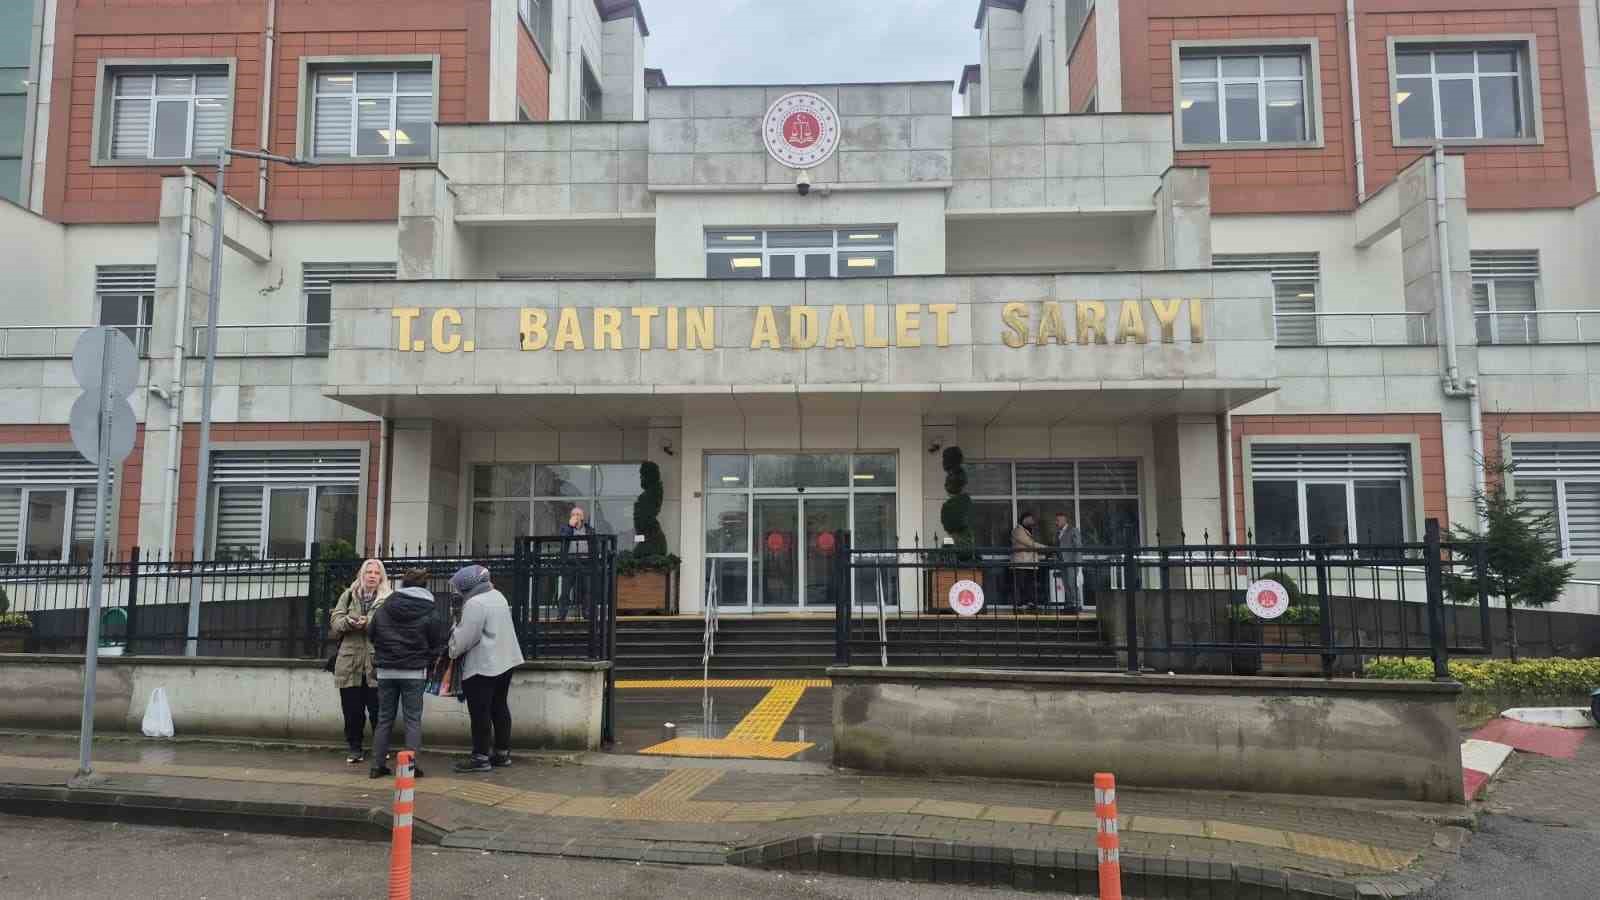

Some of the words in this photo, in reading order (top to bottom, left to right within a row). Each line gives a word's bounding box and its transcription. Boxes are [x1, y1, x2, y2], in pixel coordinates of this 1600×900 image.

[391, 307, 475, 353] T.C.
[519, 305, 714, 351] BARTIN
[751, 303, 957, 350] ADALET
[1002, 298, 1205, 348] SARAYI
